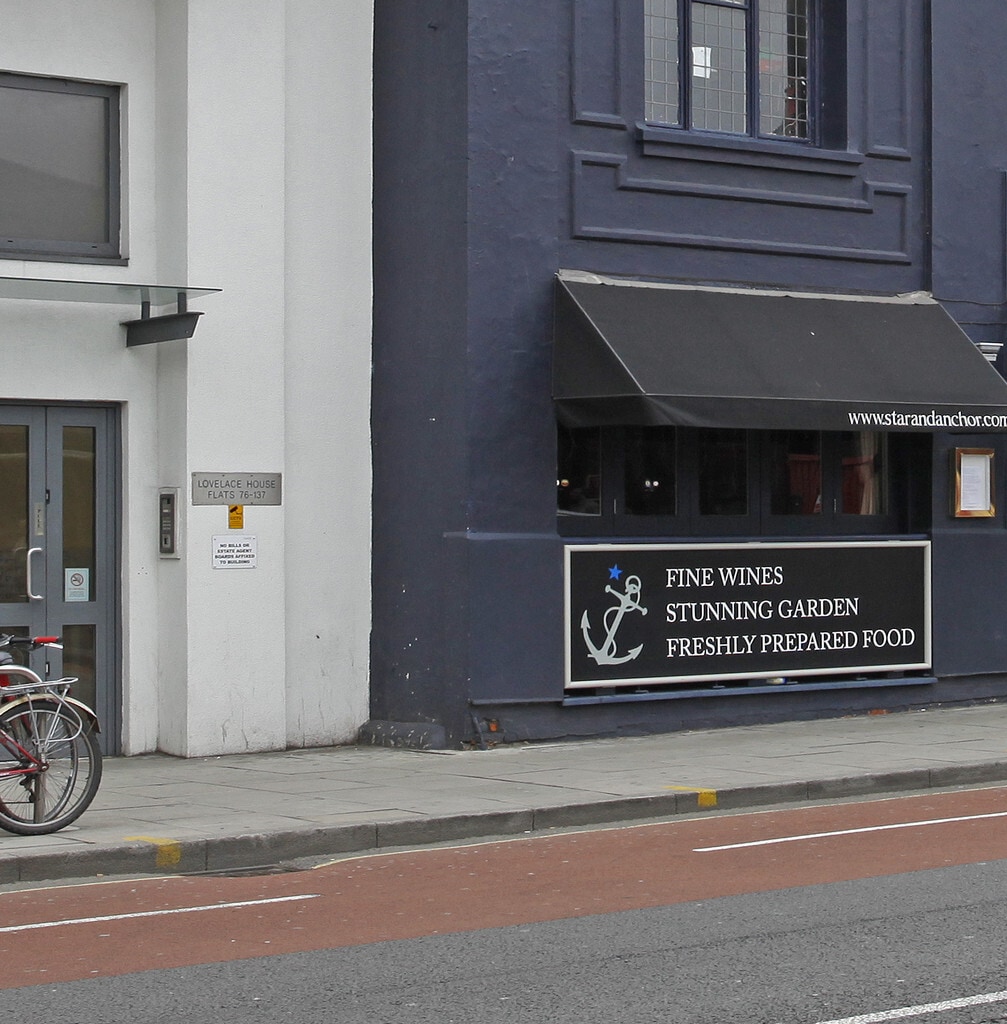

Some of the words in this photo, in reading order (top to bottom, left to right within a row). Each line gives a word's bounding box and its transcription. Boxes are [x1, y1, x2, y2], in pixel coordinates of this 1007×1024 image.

[197, 479, 242, 489] LOVELACE
[246, 479, 276, 489] HOUSE
[208, 491, 235, 499] FLATS
[239, 491, 266, 499] 76-137
[666, 568, 714, 588] FINE
[718, 566, 784, 586] WINES
[666, 600, 775, 623] STUNNING
[778, 597, 860, 619] GARDEN
[666, 635, 758, 658] FRESHLY
[760, 631, 859, 653] PREPARED
[862, 628, 915, 648] FOOD
